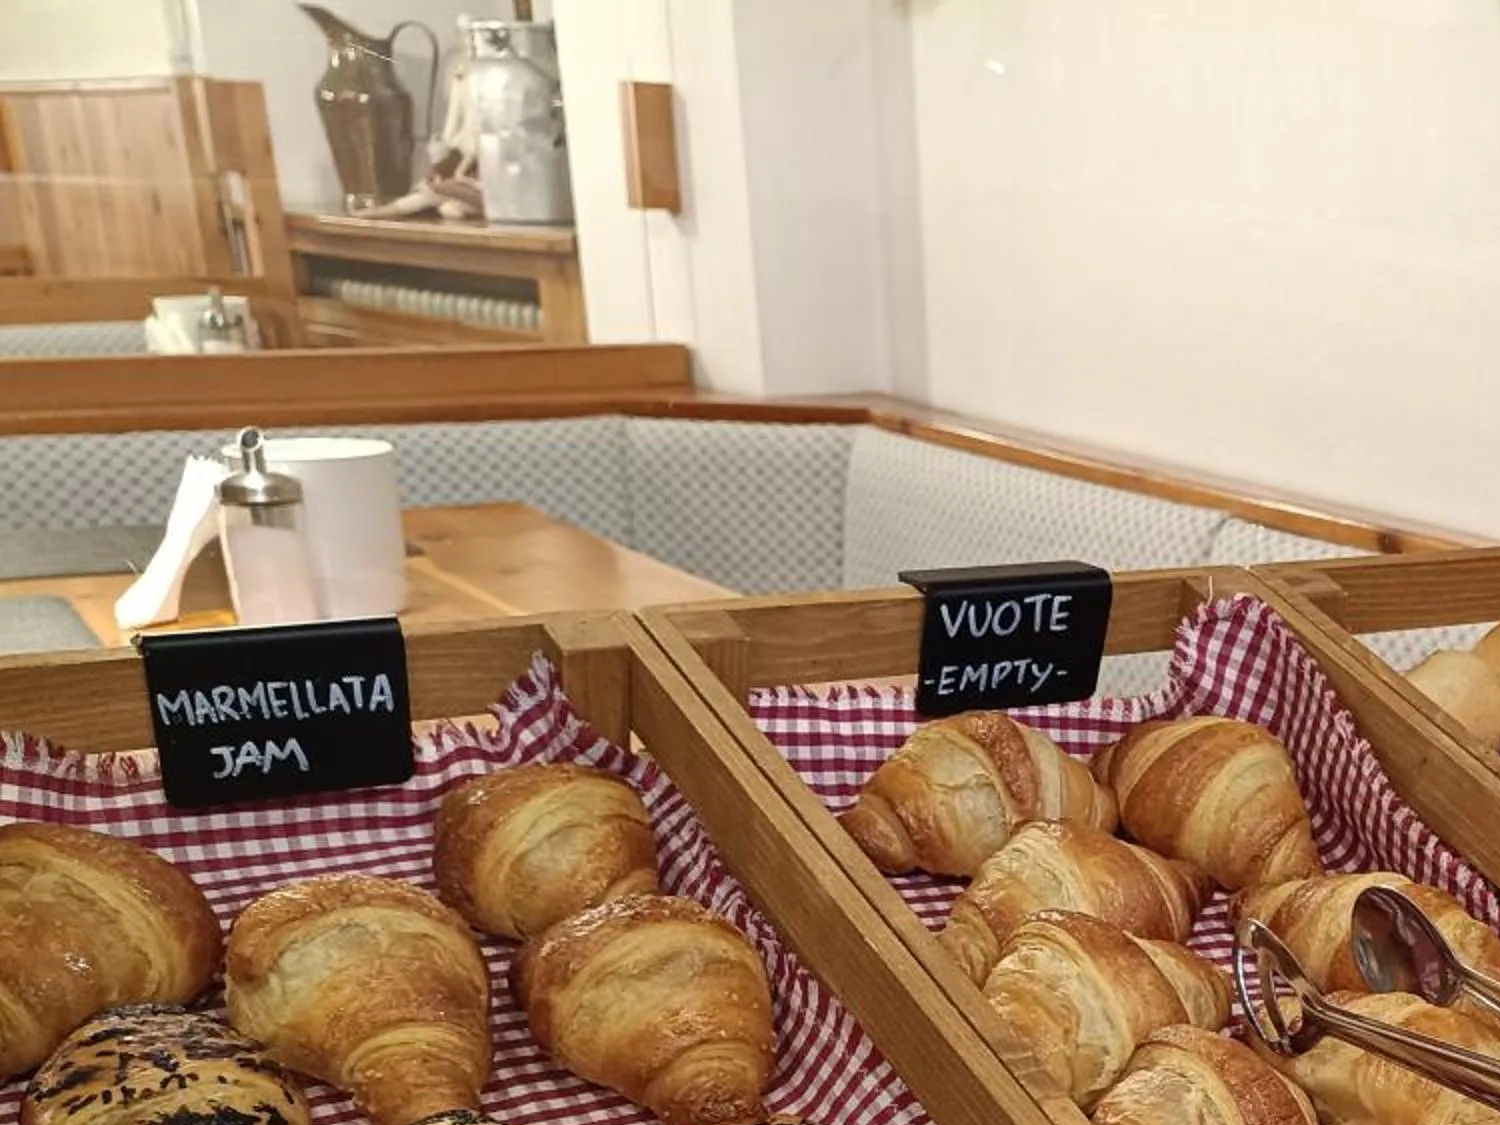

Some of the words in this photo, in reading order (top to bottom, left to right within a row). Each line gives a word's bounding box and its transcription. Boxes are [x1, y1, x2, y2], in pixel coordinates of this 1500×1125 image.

[940, 593, 1073, 639] VUOTE
[156, 672, 396, 727] MARMELLATA
[209, 737, 311, 779] JAM
